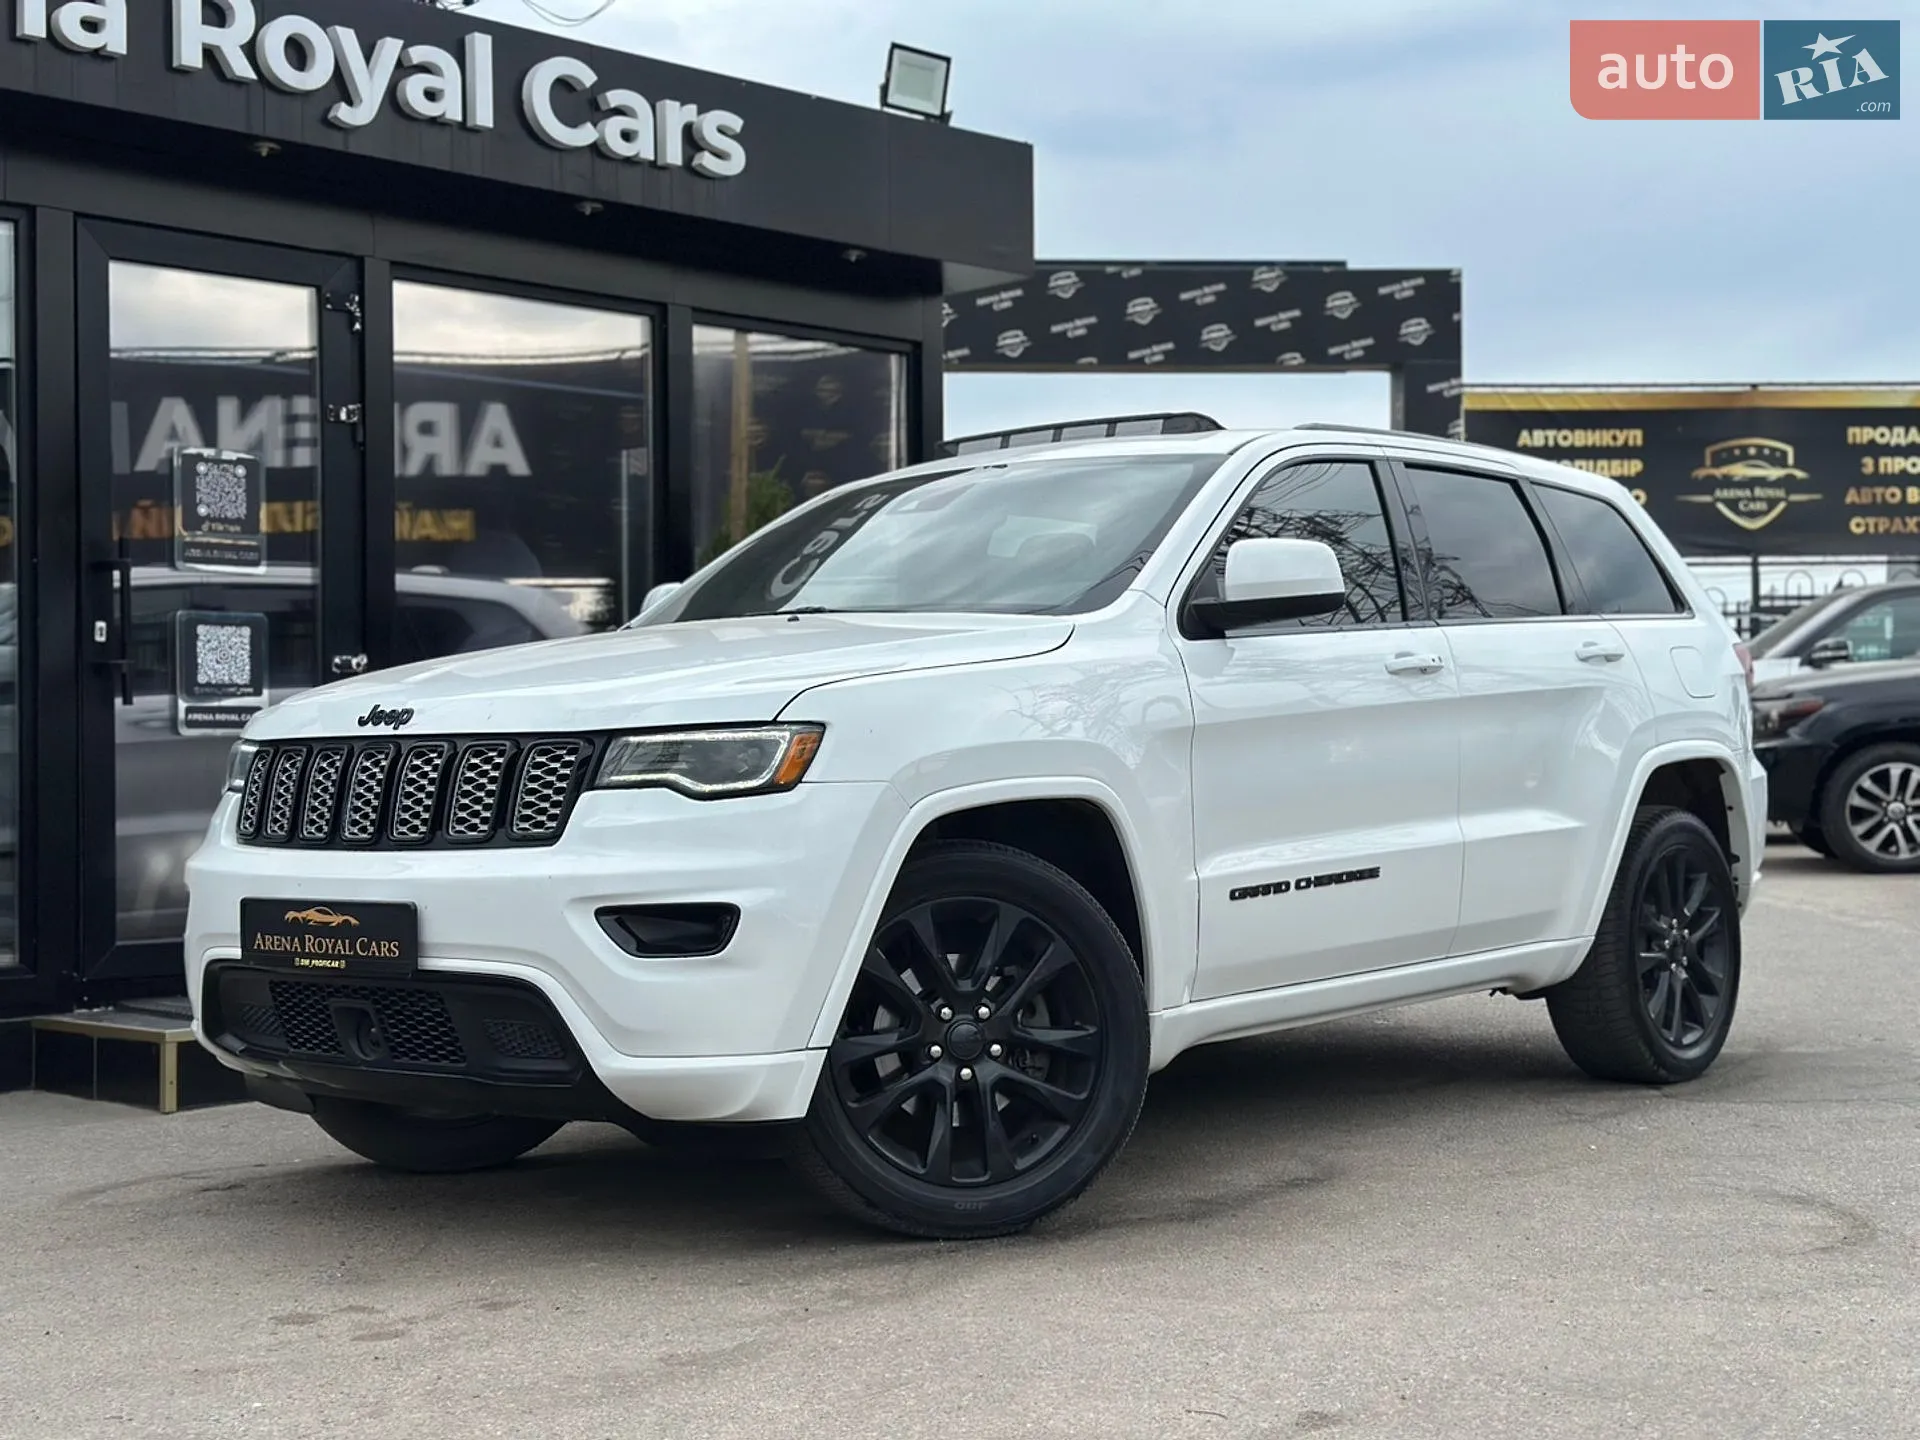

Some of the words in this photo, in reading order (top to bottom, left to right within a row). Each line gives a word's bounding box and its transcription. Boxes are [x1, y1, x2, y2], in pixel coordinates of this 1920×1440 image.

[172, 0, 493, 130] Royal
[522, 56, 746, 178] Cars
[1516, 428, 1643, 447] АВТОВИКУП
[1844, 487, 1903, 505] АВТО
[1849, 516, 1920, 535] СТРАХ
[357, 703, 415, 731] Jeep
[253, 931, 301, 953] ARENA
[305, 934, 353, 955] ROYAL
[356, 937, 400, 958] CARS
